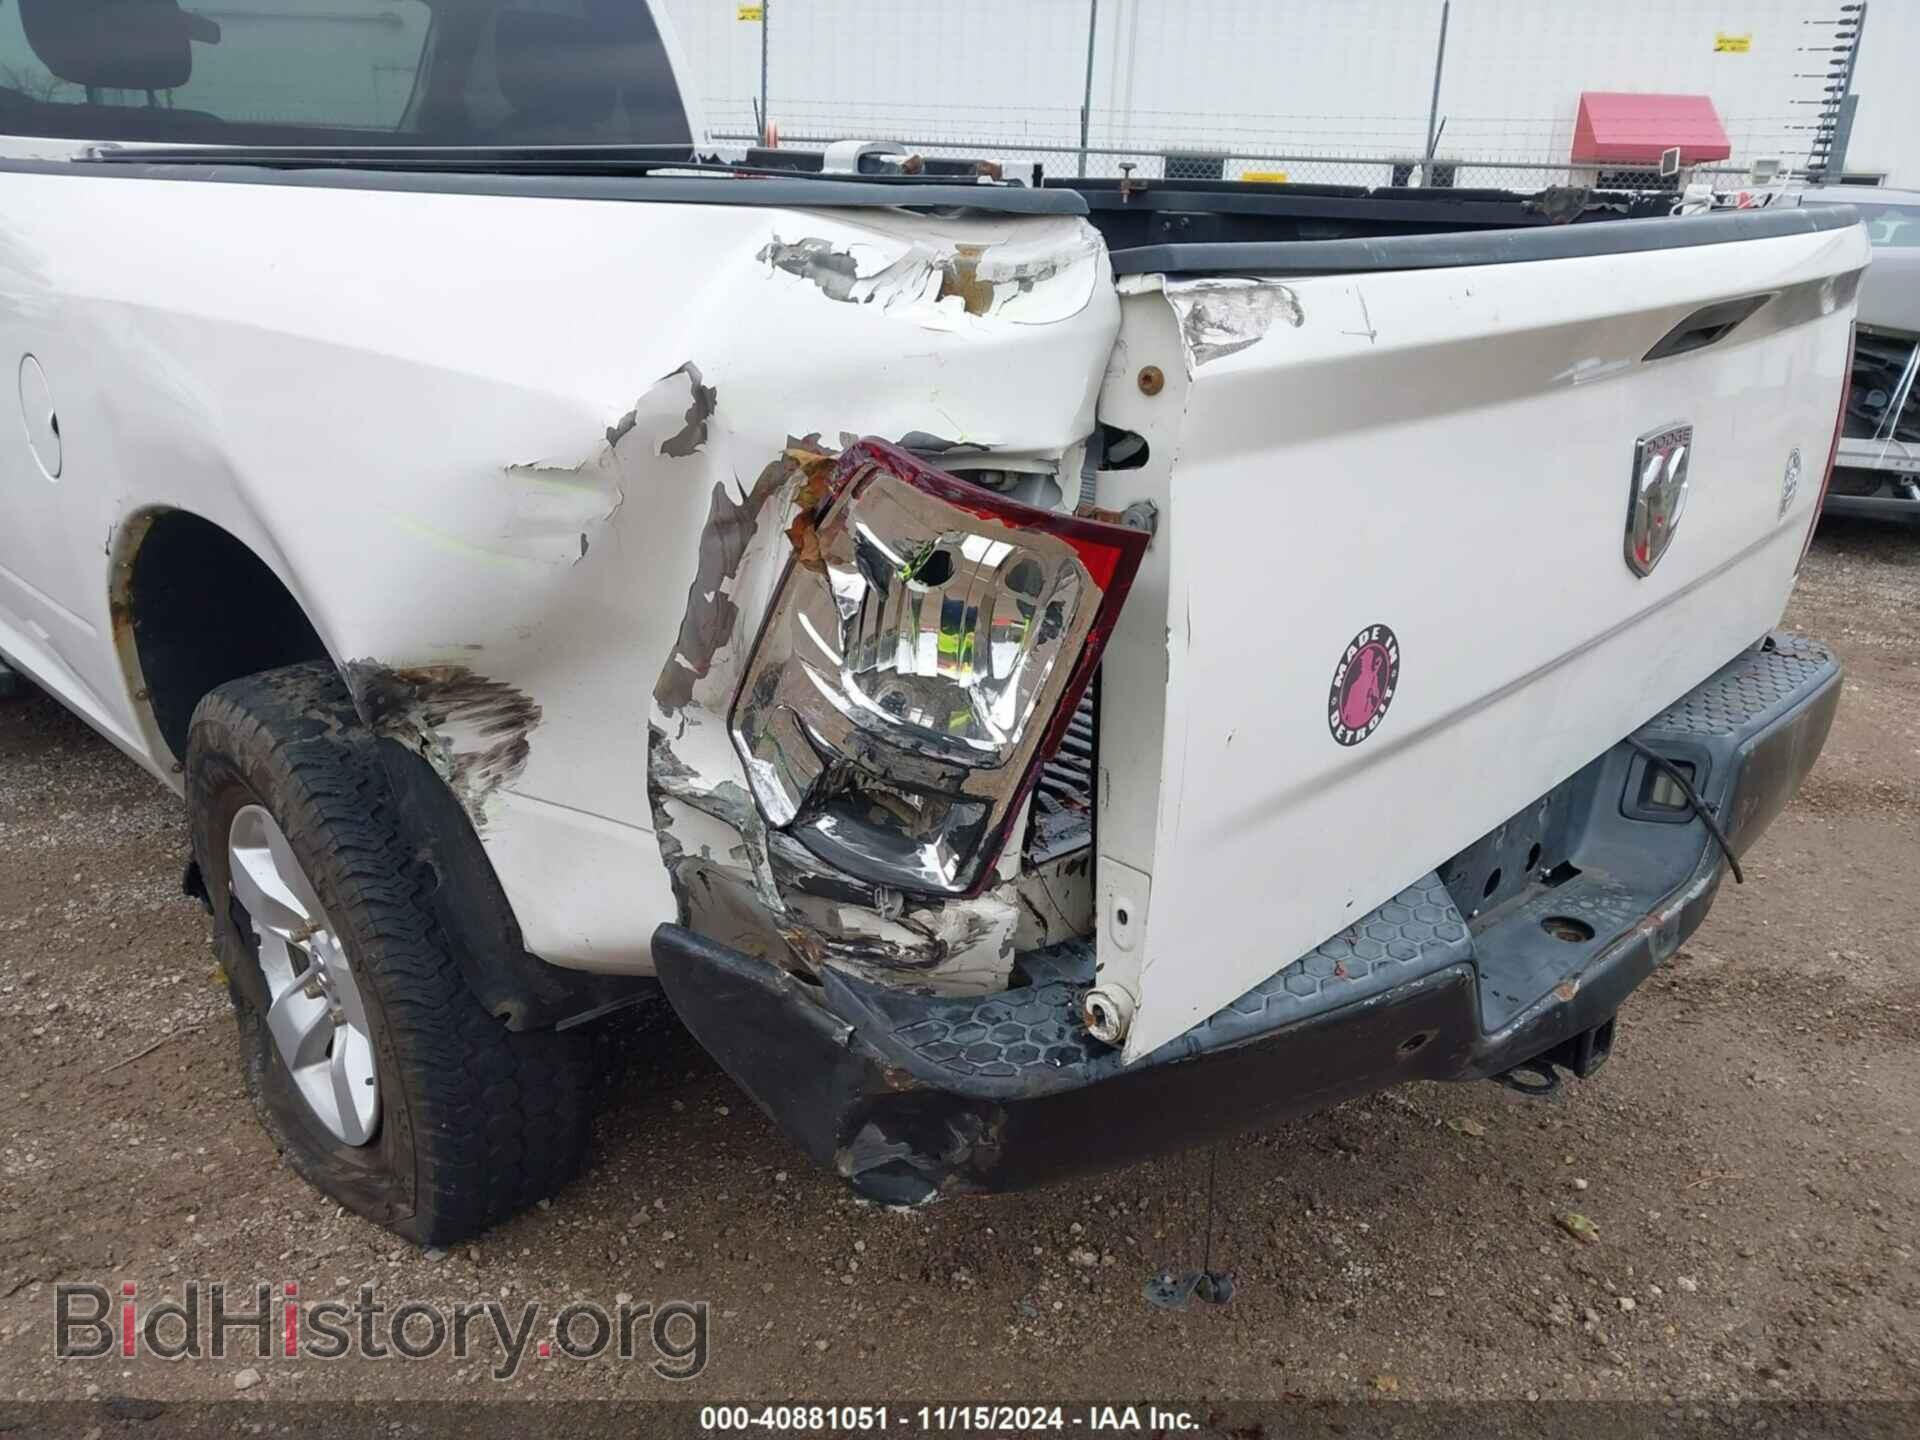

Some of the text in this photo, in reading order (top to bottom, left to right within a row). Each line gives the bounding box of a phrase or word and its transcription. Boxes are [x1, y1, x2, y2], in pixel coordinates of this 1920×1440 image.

[1647, 427, 1692, 453] DODGE
[1333, 626, 1398, 688] MADE IN
[1330, 688, 1393, 744] DETROIT
